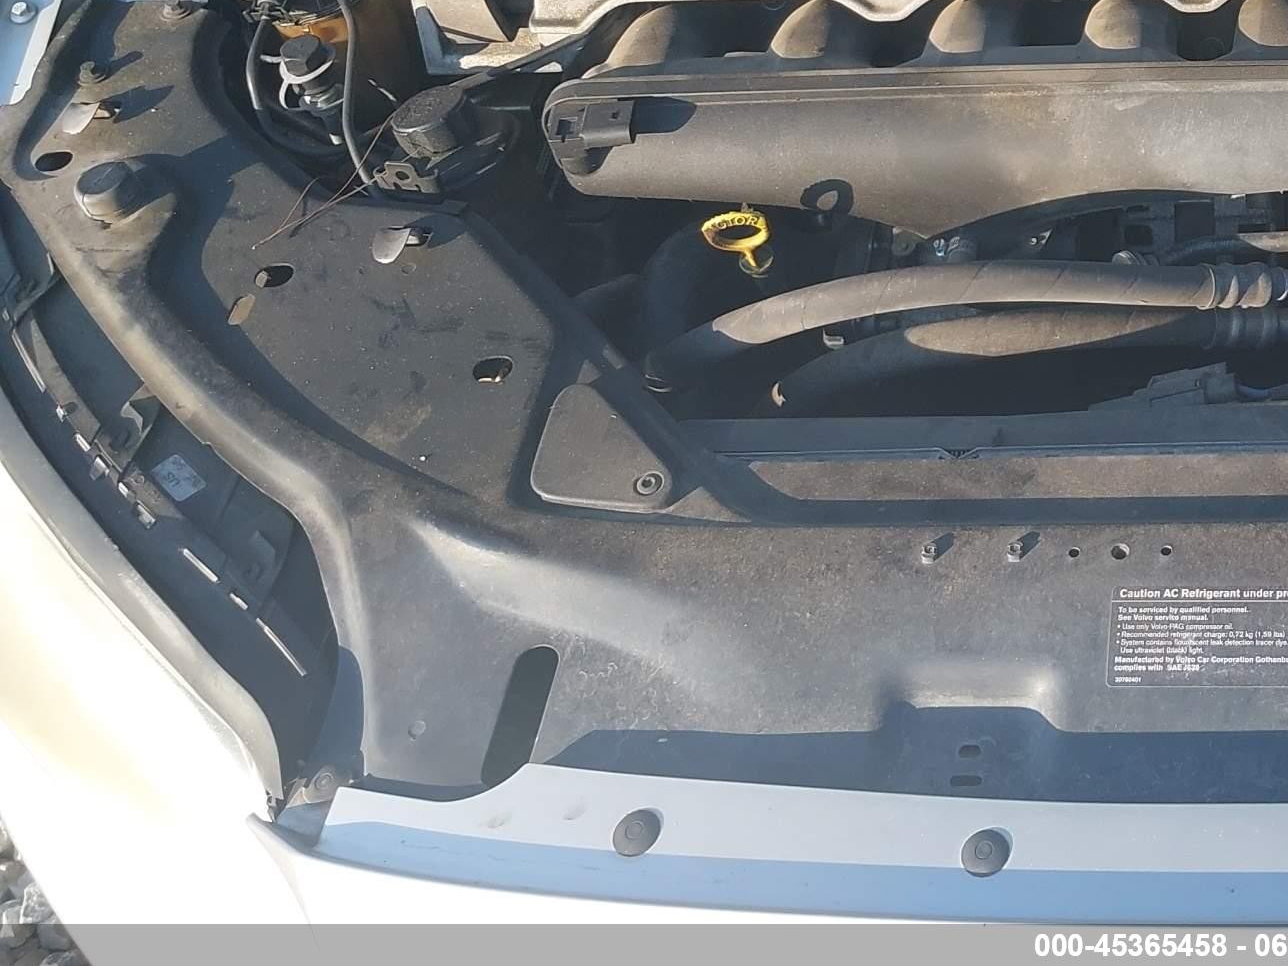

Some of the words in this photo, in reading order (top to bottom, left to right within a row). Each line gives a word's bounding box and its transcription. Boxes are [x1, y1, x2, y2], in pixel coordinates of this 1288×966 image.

[1119, 588, 1161, 598] Caution
[1163, 588, 1179, 598] AC
[1181, 588, 1241, 600] Refrigerant
[1243, 588, 1274, 598] under
[1169, 606, 1178, 615] by
[1179, 606, 1210, 615] qualified
[1211, 606, 1249, 615] personnel.
[1136, 623, 1149, 631] only
[1185, 623, 1224, 631] compressor
[1245, 631, 1254, 640] kg
[1120, 638, 1144, 647] System
[1210, 638, 1223, 646] leak
[1224, 638, 1255, 646] detection
[1255, 638, 1275, 646] tracer
[1165, 656, 1175, 665] by
[1210, 656, 1254, 665] Corporation
[1113, 664, 1147, 672] complies
